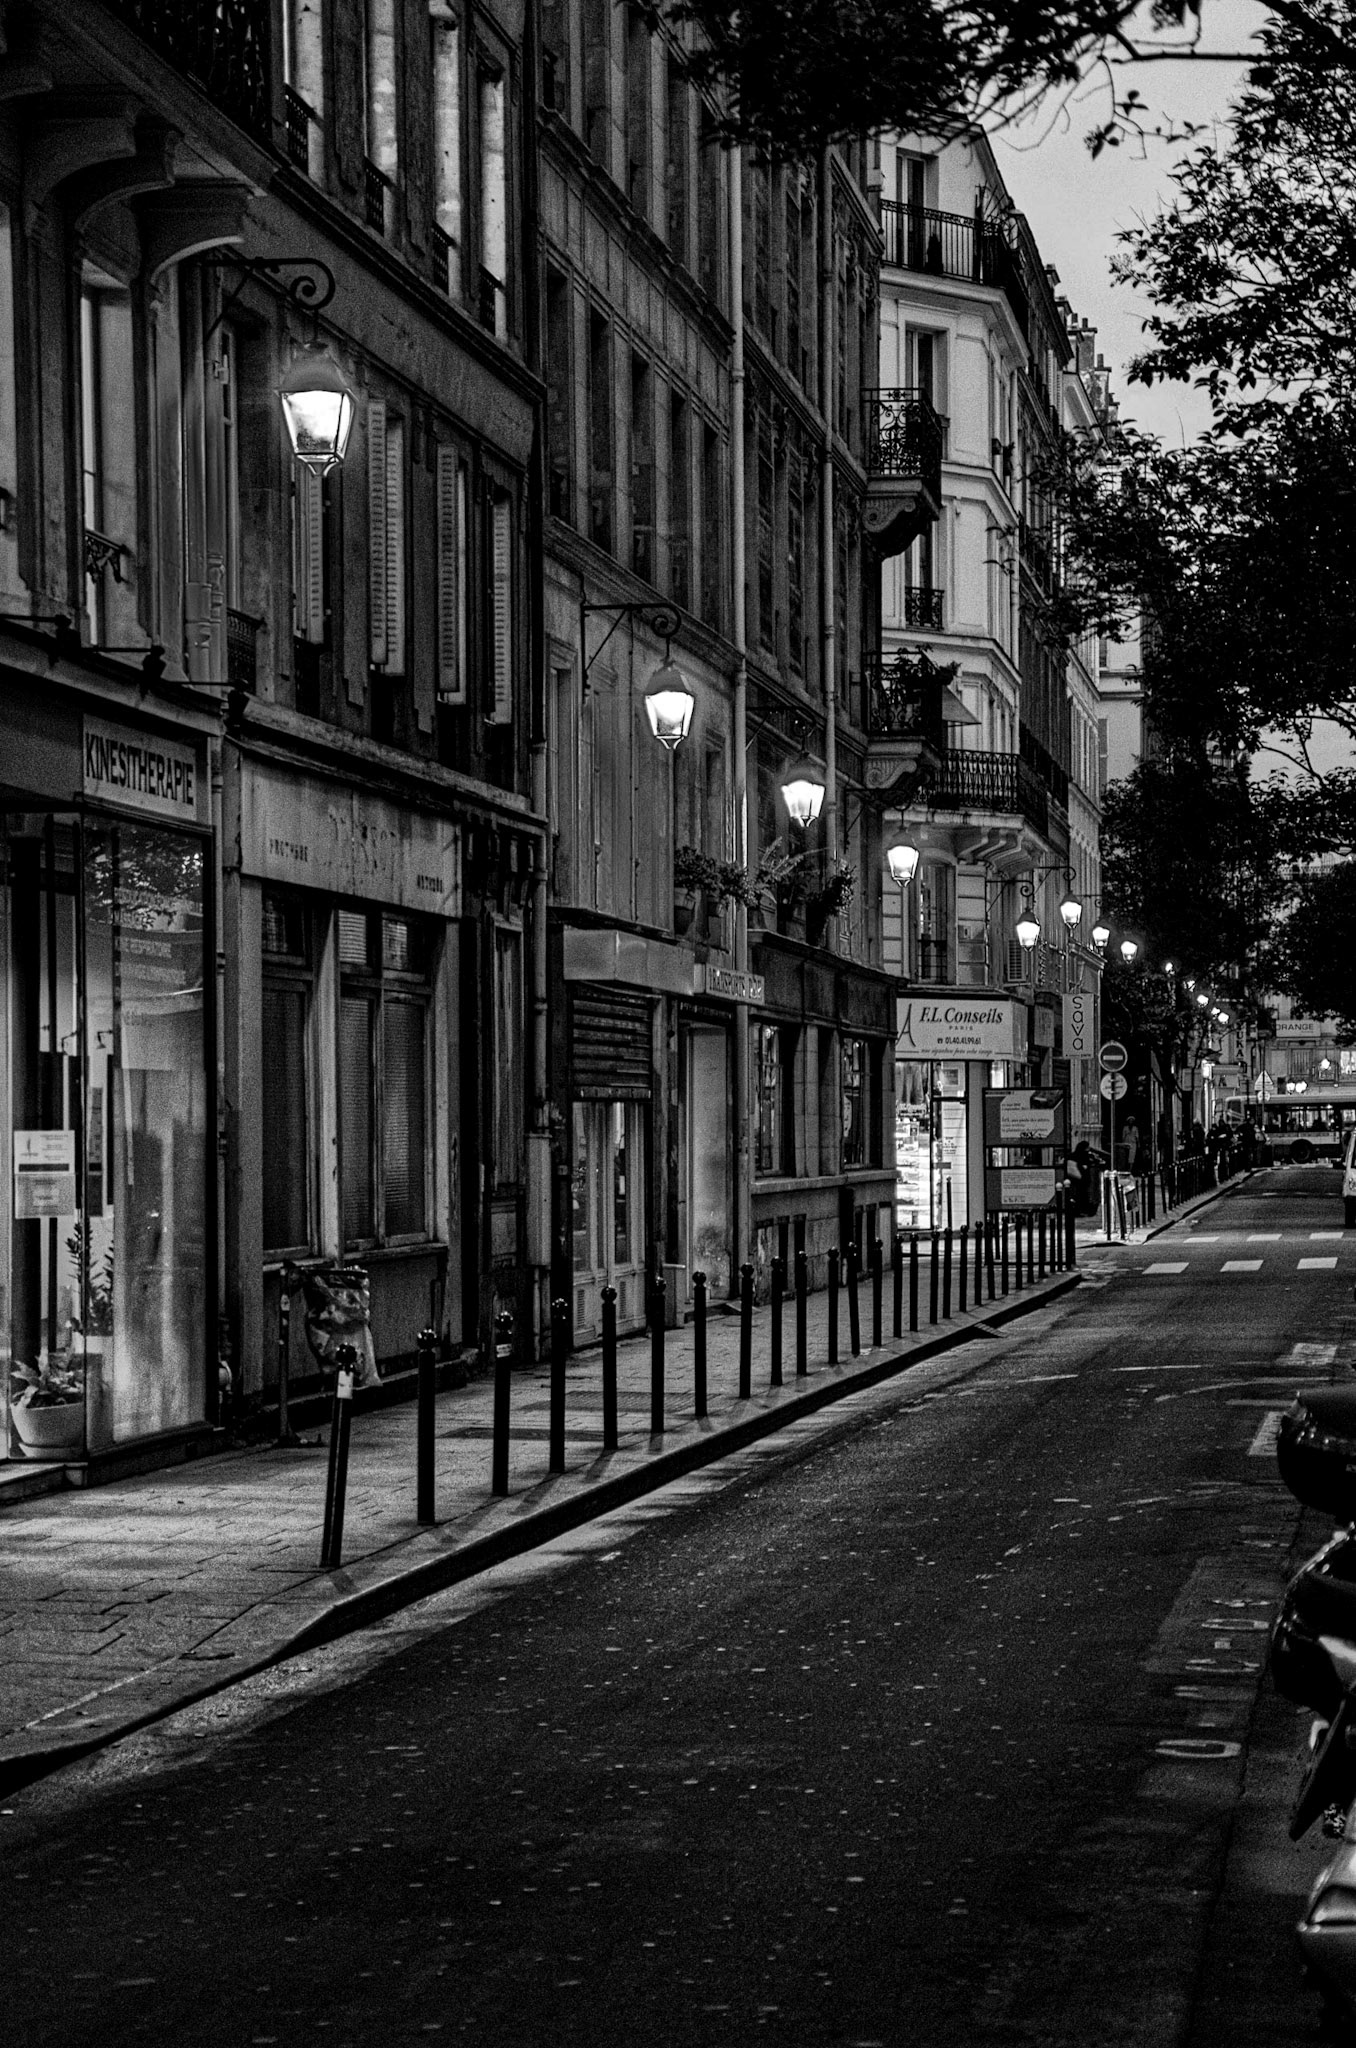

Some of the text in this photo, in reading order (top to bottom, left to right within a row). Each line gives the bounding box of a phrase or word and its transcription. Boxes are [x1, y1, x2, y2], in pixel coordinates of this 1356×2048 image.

[85, 732, 194, 806] KINESITHERAPIE
[944, 1007, 1004, 1024] Conseils
[1275, 1023, 1314, 1031] ORANGE
